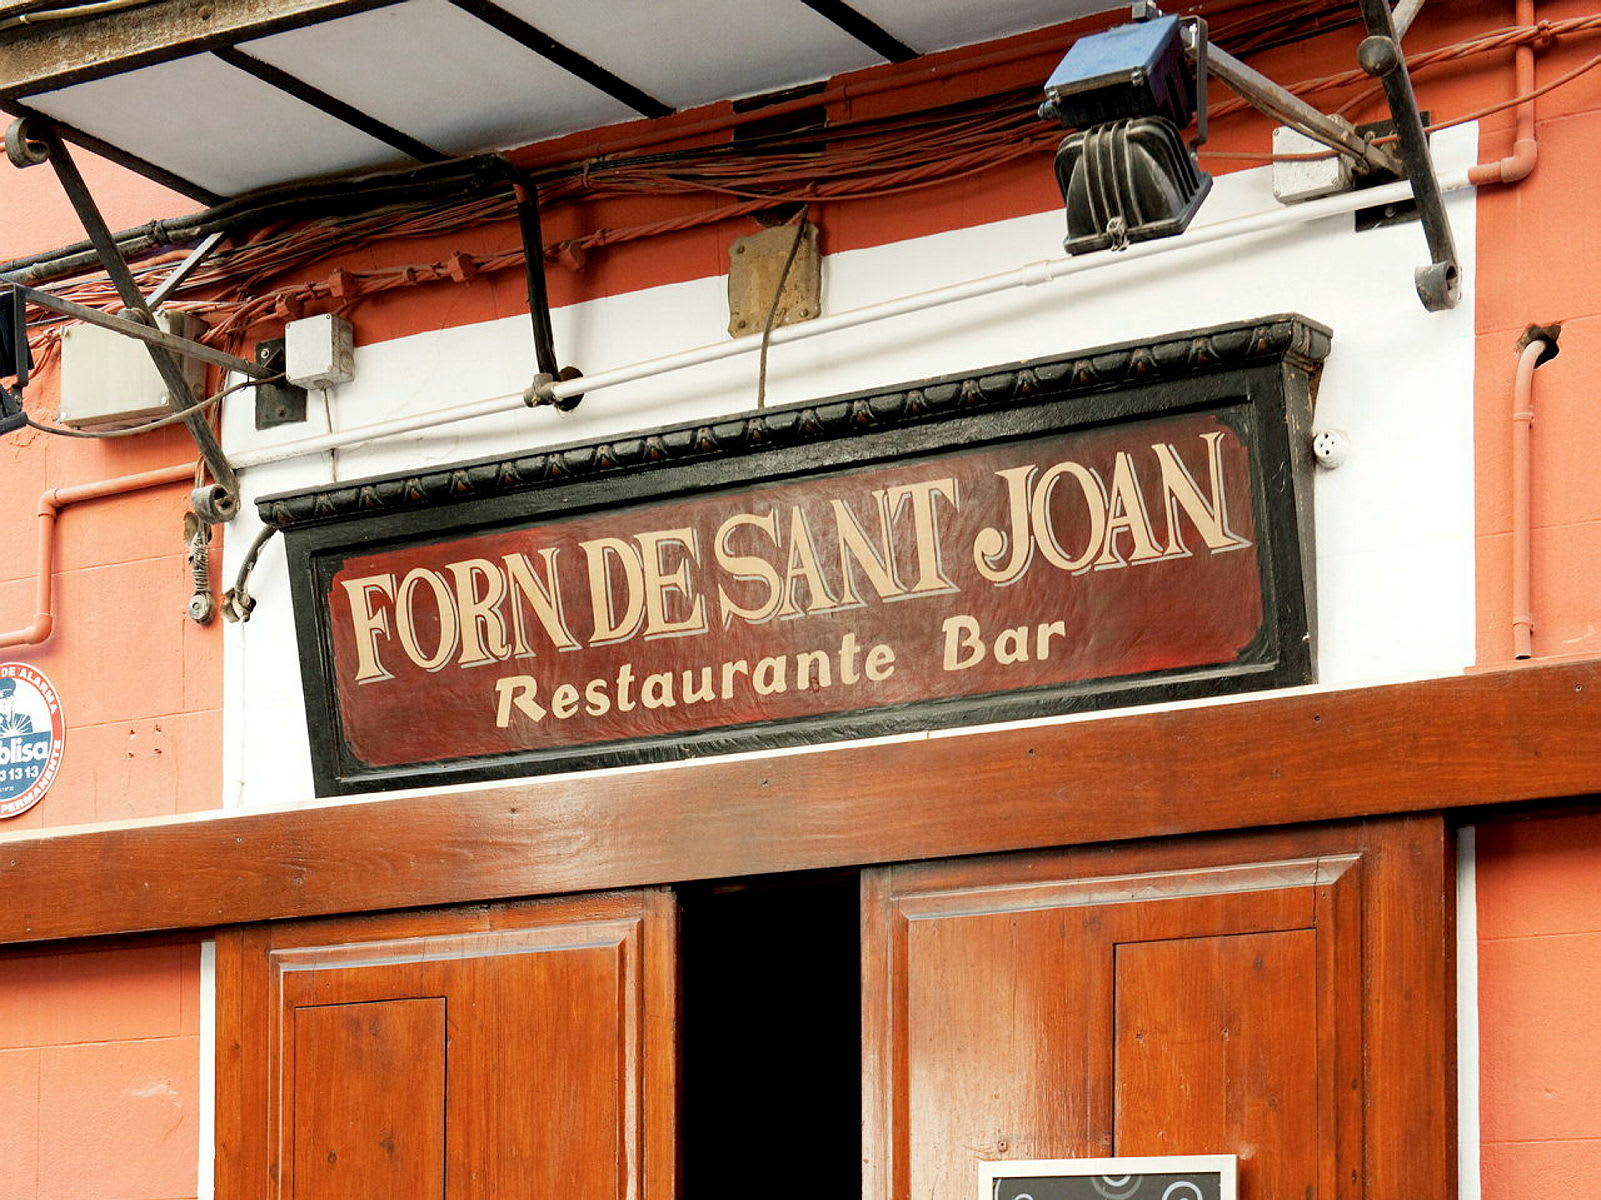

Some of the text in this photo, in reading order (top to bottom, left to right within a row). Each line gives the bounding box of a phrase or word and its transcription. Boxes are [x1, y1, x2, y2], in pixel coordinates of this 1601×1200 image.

[340, 431, 1253, 685] FORN DE SANT JOAN
[1, 667, 58, 715] DE ALARMA
[495, 614, 1066, 729] Restaurante Bar
[1, 739, 61, 813] PERMANENTE
[9, 768, 23, 780] 13
[25, 766, 39, 779] 13
